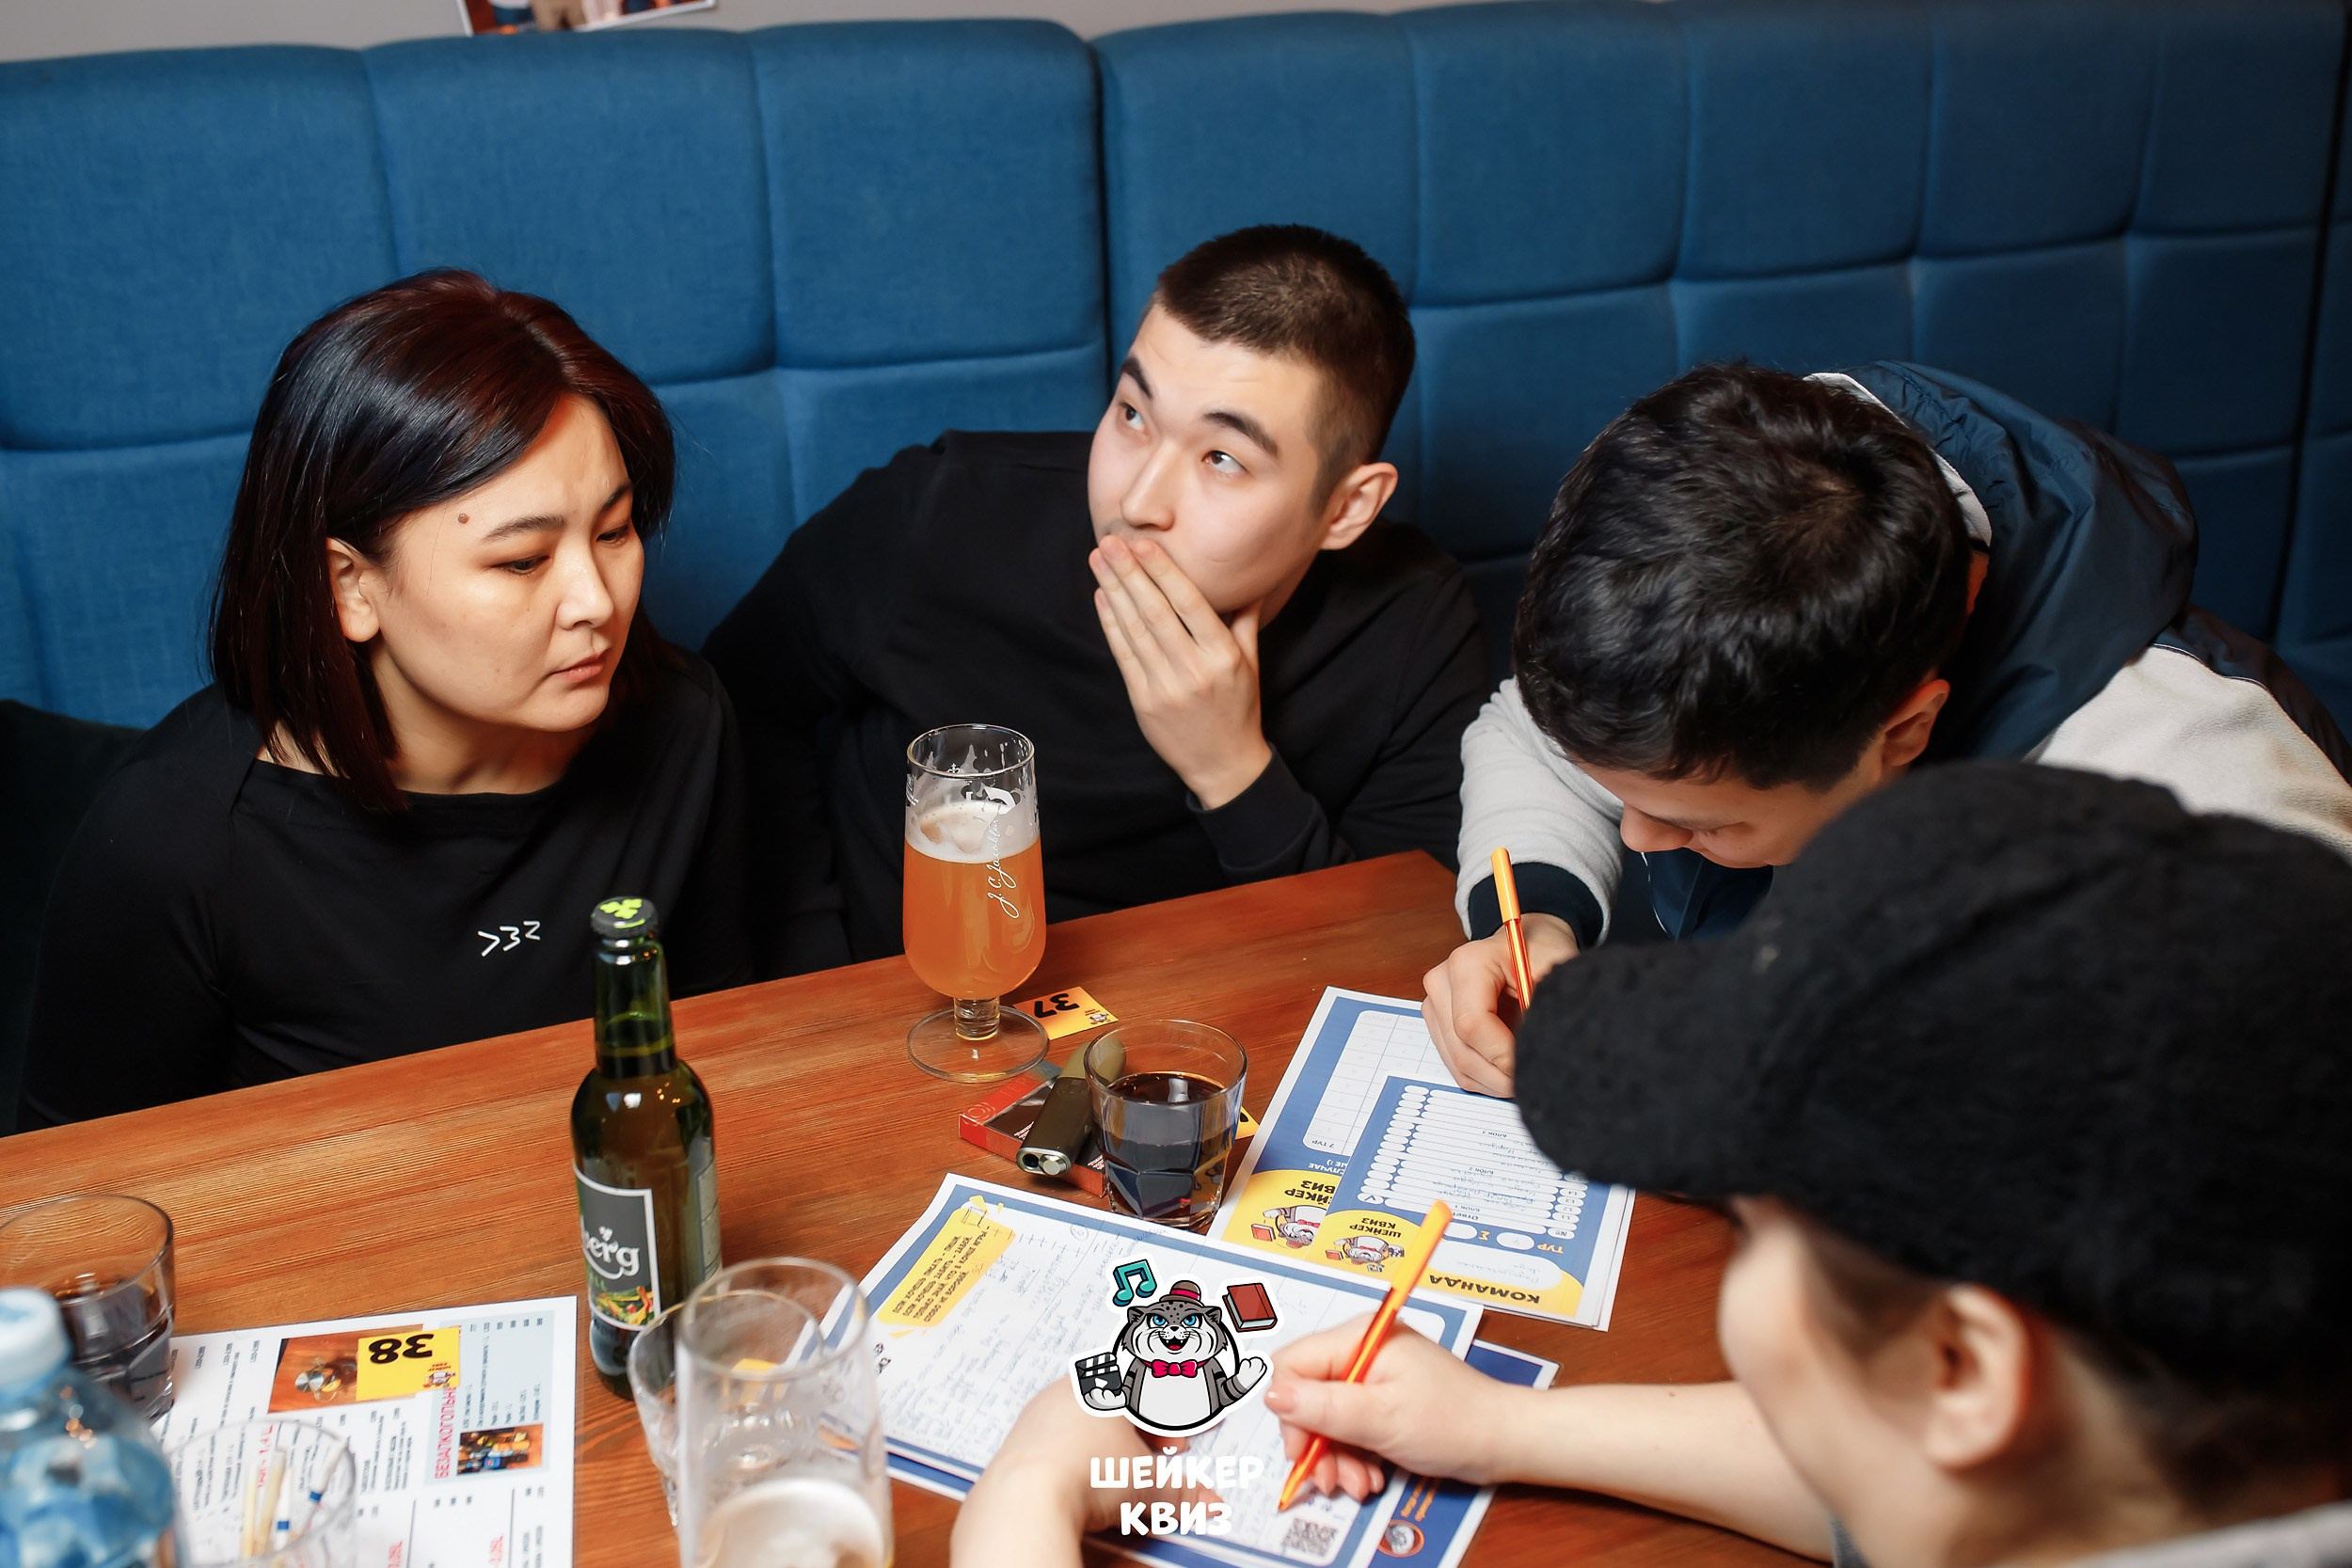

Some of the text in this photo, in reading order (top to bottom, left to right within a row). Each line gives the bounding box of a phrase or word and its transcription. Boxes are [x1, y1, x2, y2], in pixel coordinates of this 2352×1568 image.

[1034, 991, 1079, 1019] 37
[1300, 1180, 1335, 1193] ВИЗ
[1349, 1223, 1401, 1238] ШЕЙКЕР
[1360, 1216, 1396, 1227] КВИЗ
[1479, 1230, 1490, 1241] Σ
[1536, 1243, 1564, 1254] ТУР
[913, 1298, 933, 1318] ТОЛЬКО
[946, 1270, 957, 1280] ЧТО
[960, 1247, 975, 1263] КОНЦЕ
[974, 1231, 988, 1246] ИГРЫ
[893, 1300, 905, 1313] ЕСЛИ
[906, 1278, 926, 1298] ХОЧЕШЬ
[903, 1304, 915, 1316] ЕСЛИ
[916, 1281, 936, 1302] ХОЧЕШЬ
[934, 1260, 953, 1279] ЗАБИТЬ
[1427, 1274, 1540, 1304] КОМАНДА
[924, 1305, 941, 1322] СЛОВО
[367, 1334, 434, 1363] 38
